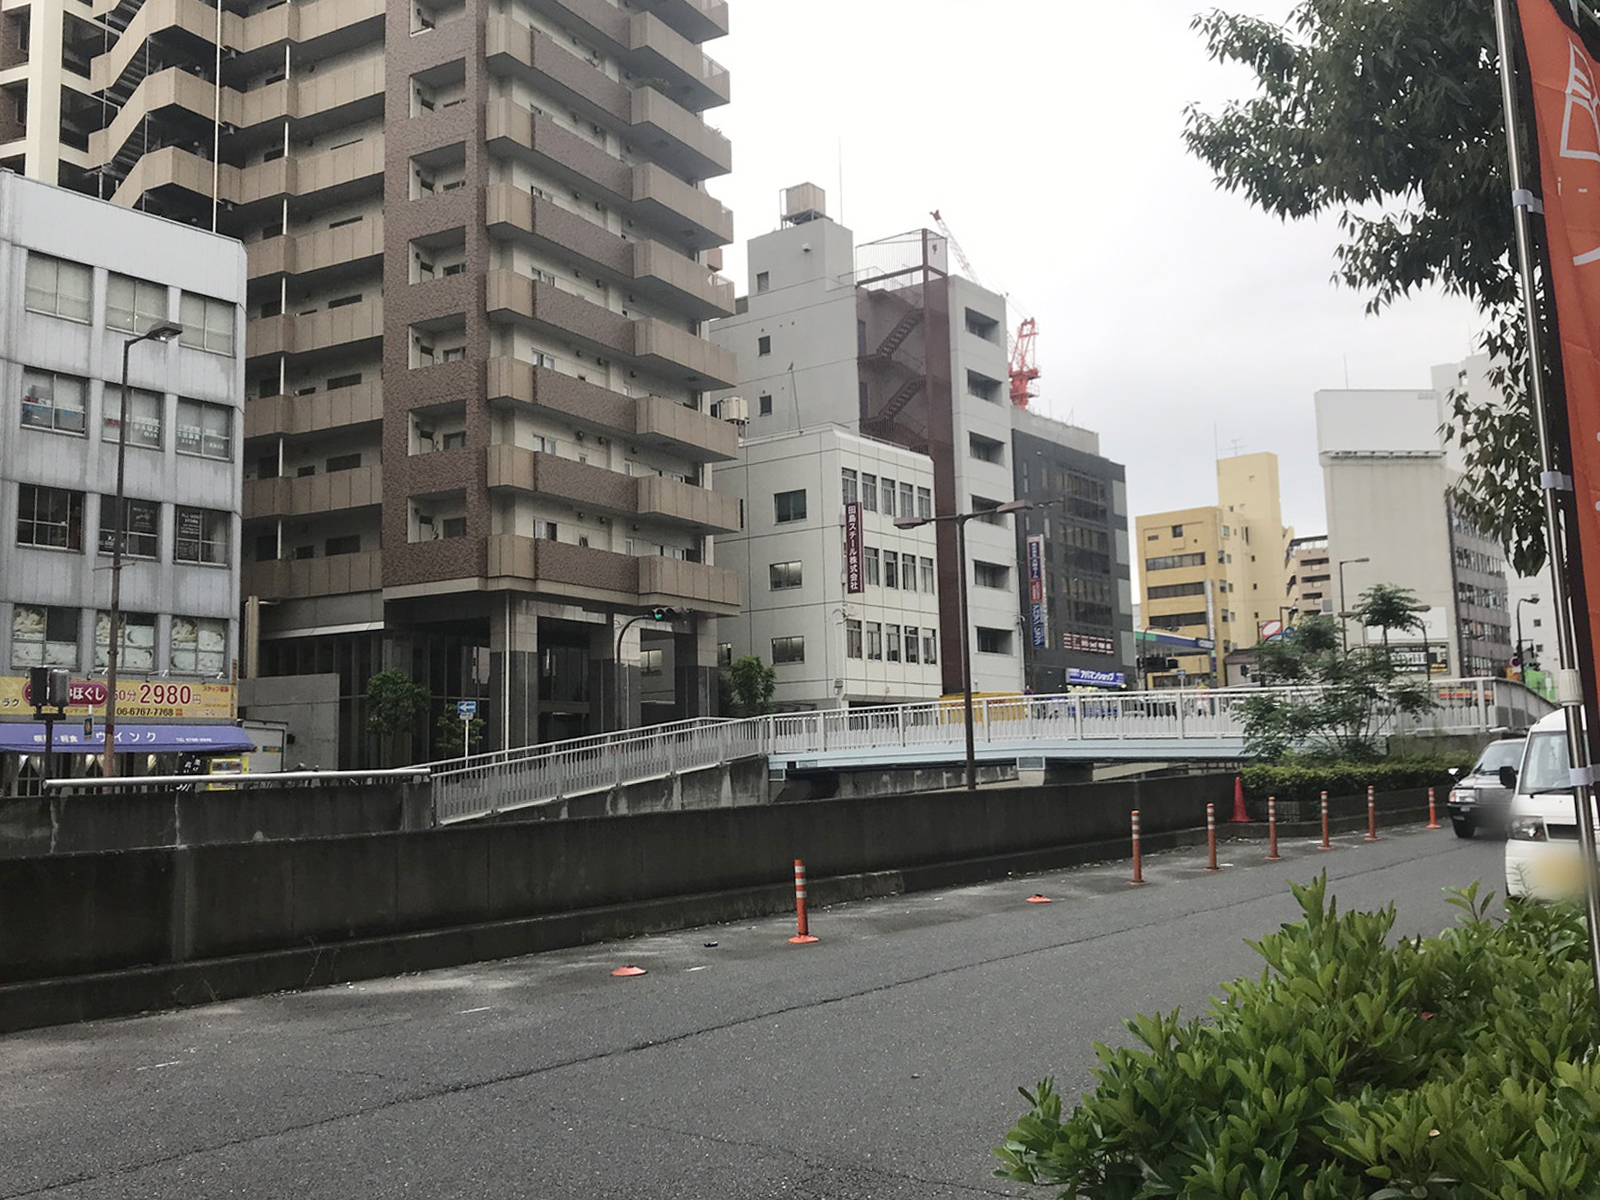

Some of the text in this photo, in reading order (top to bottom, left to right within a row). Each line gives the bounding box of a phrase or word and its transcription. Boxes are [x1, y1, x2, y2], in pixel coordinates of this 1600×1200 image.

[847, 505, 858, 590] 田島スチール株式会社
